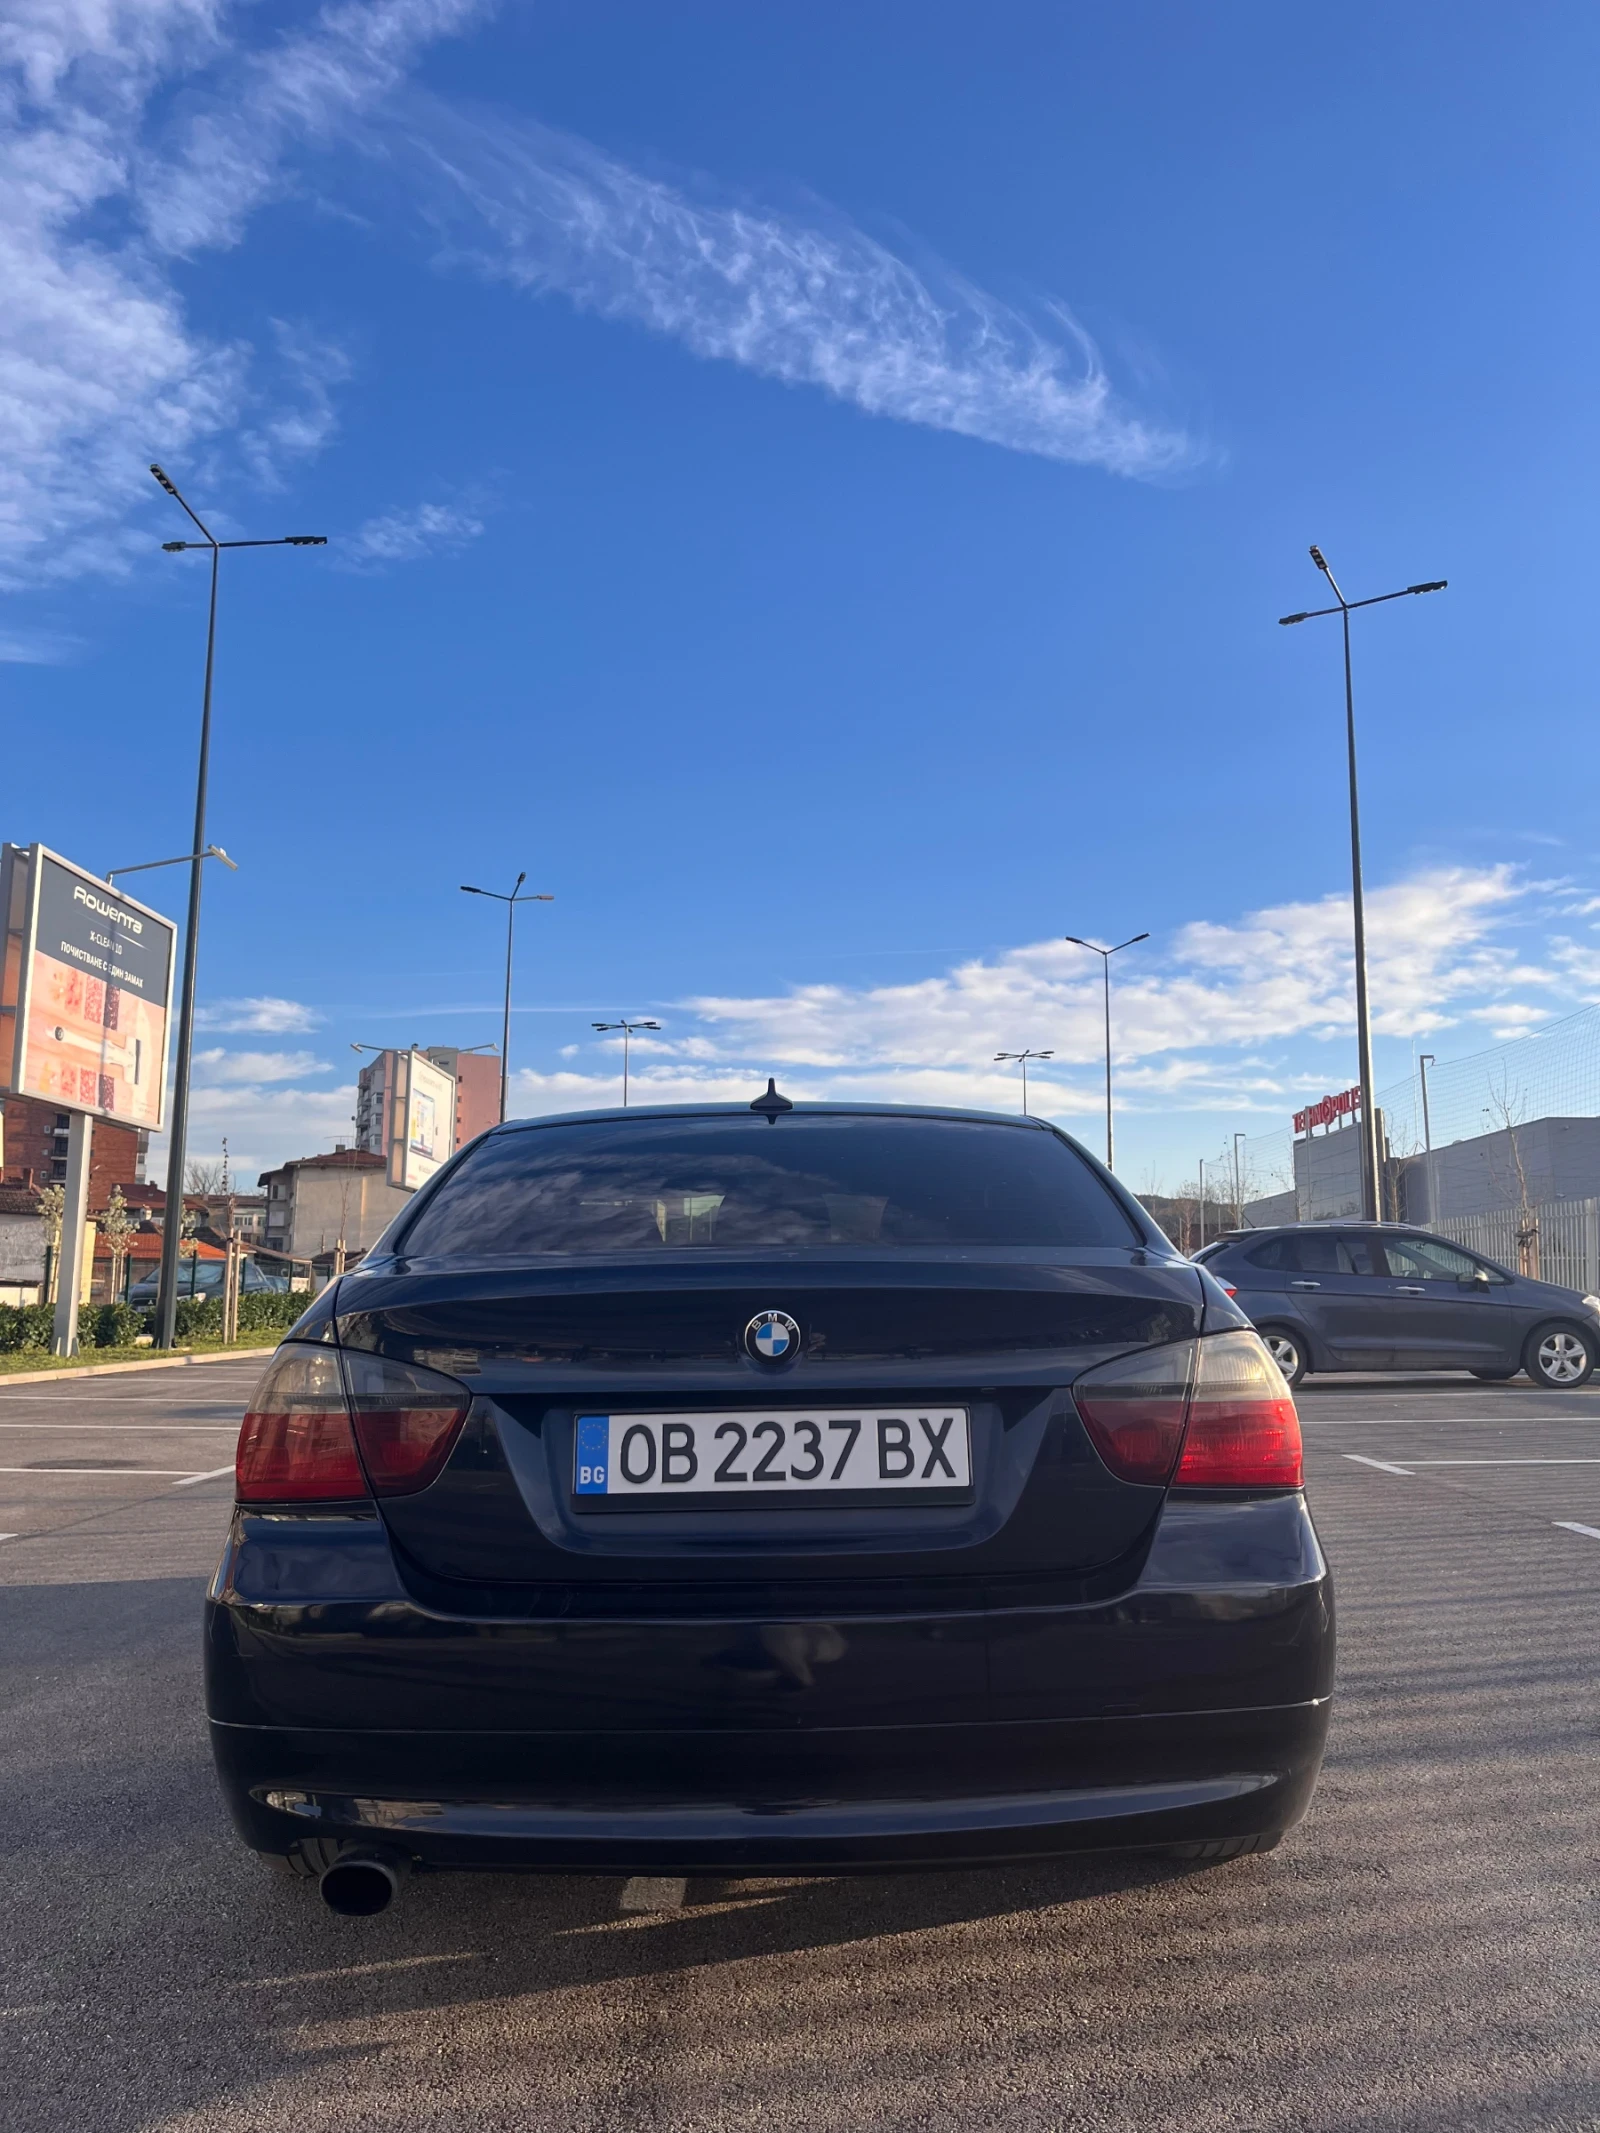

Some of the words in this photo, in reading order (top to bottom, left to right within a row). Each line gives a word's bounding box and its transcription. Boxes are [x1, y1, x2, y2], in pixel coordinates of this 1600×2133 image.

[90, 930, 115, 951] X-CLEAN
[61, 941, 102, 969] ПОЧИСТВАНЕ
[108, 963, 124, 979] ЕДИН
[124, 970, 144, 988] ЗАМАХ
[751, 1313, 796, 1331] BMW
[620, 1423, 698, 1484] OB
[714, 1420, 861, 1482] 2237
[877, 1418, 957, 1479] BX
[579, 1466, 605, 1485] BG
